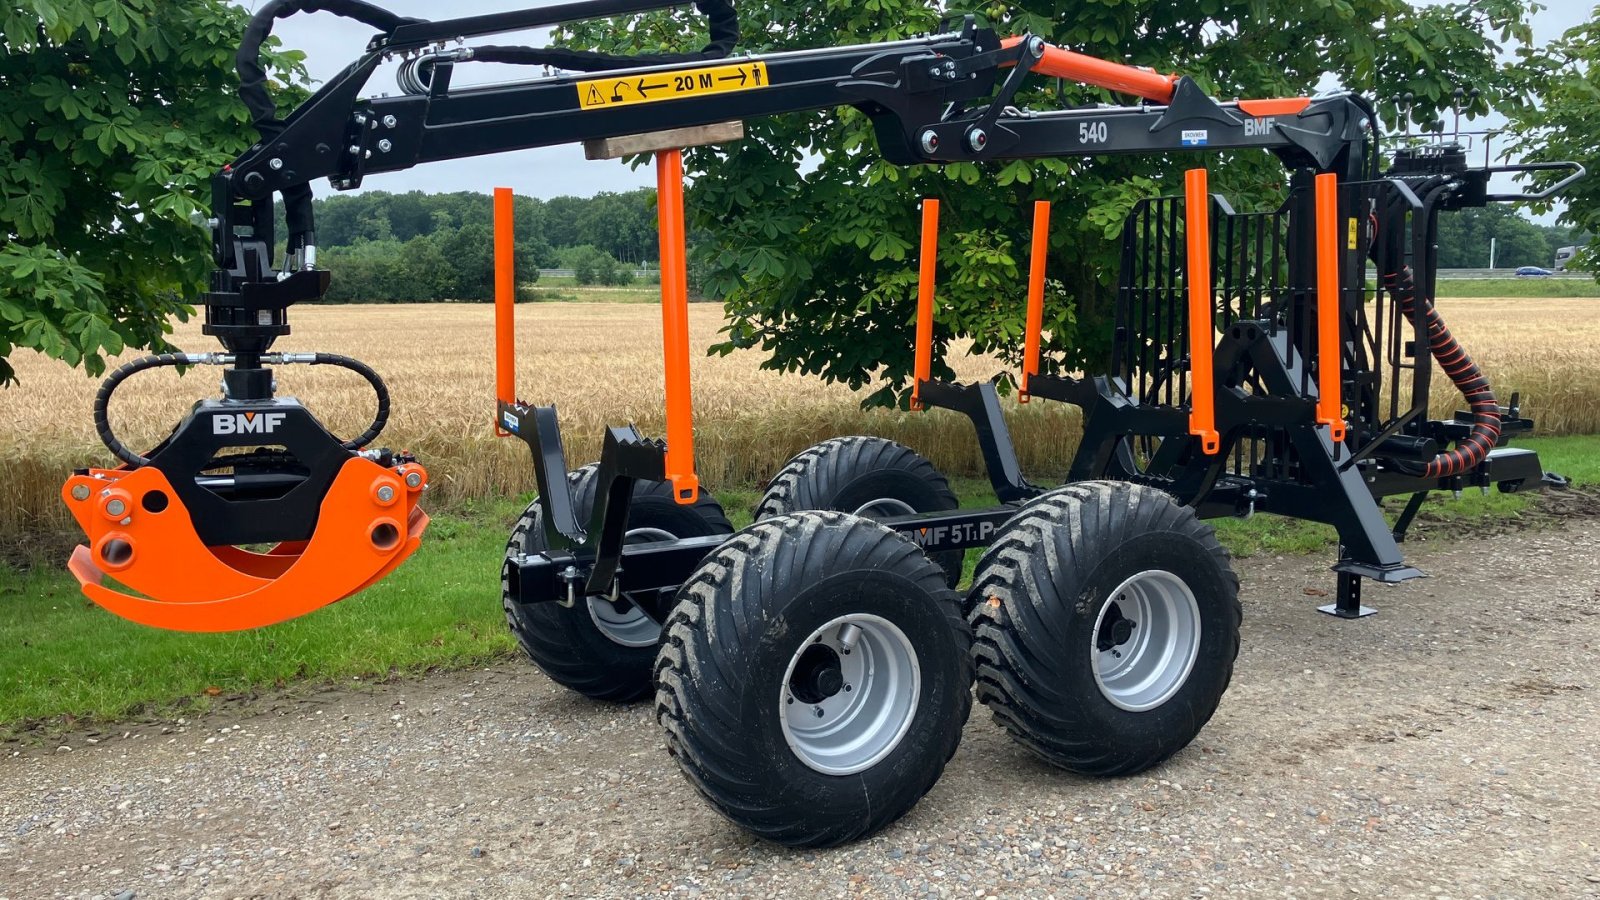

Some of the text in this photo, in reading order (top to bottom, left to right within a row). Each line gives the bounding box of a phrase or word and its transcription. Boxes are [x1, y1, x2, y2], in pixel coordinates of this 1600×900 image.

[674, 73, 713, 91] 20 M
[1079, 121, 1107, 144] 540
[1244, 117, 1275, 136] BMF
[212, 412, 287, 435] BMF
